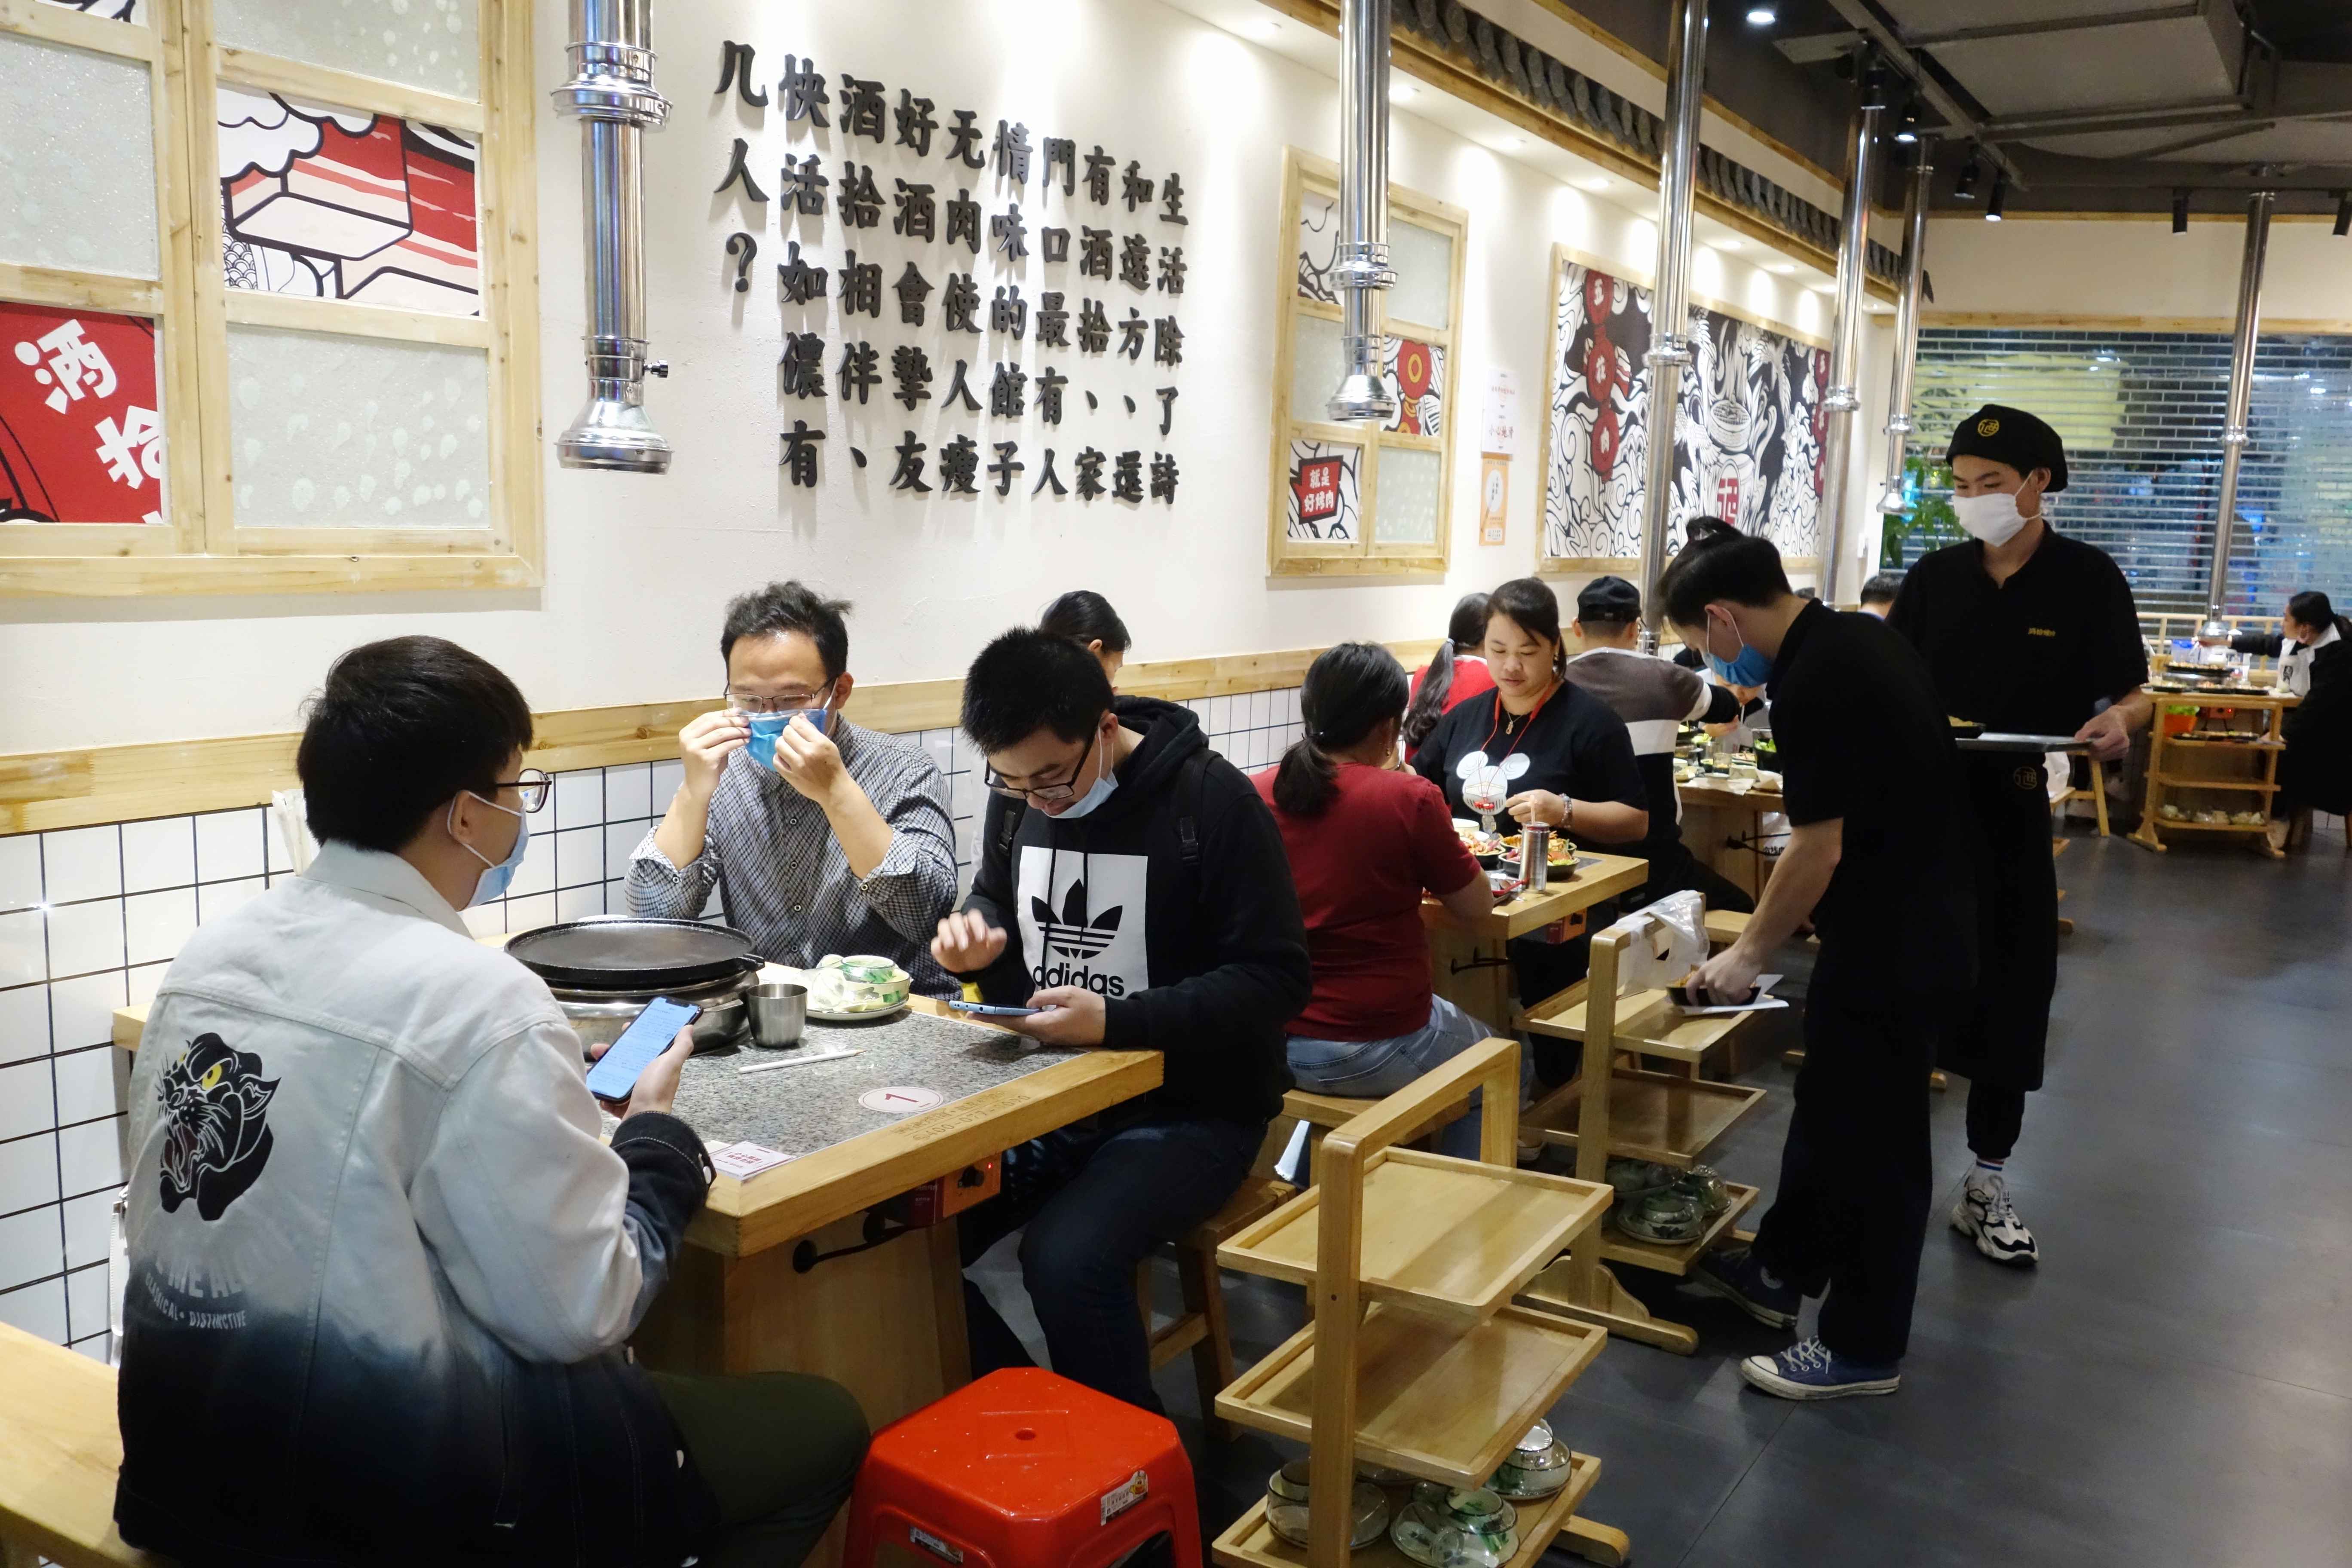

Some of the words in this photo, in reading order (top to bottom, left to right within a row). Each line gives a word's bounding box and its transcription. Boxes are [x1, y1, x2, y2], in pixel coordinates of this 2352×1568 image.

[889, 89, 939, 493] 好酒會摯友
[940, 110, 985, 494] 无肉使人瘦
[988, 119, 1033, 496] 情味的館子
[1034, 137, 1076, 495] 門口最有人
[1150, 173, 1188, 505] 生活除了詩
[1304, 490, 1334, 512] 好烤肉
[1309, 466, 1330, 489] 就是
[1033, 962, 1125, 997] adidas
[885, 1093, 919, 1103] 1
[189, 1310, 246, 1329] DISTINCTIVE
